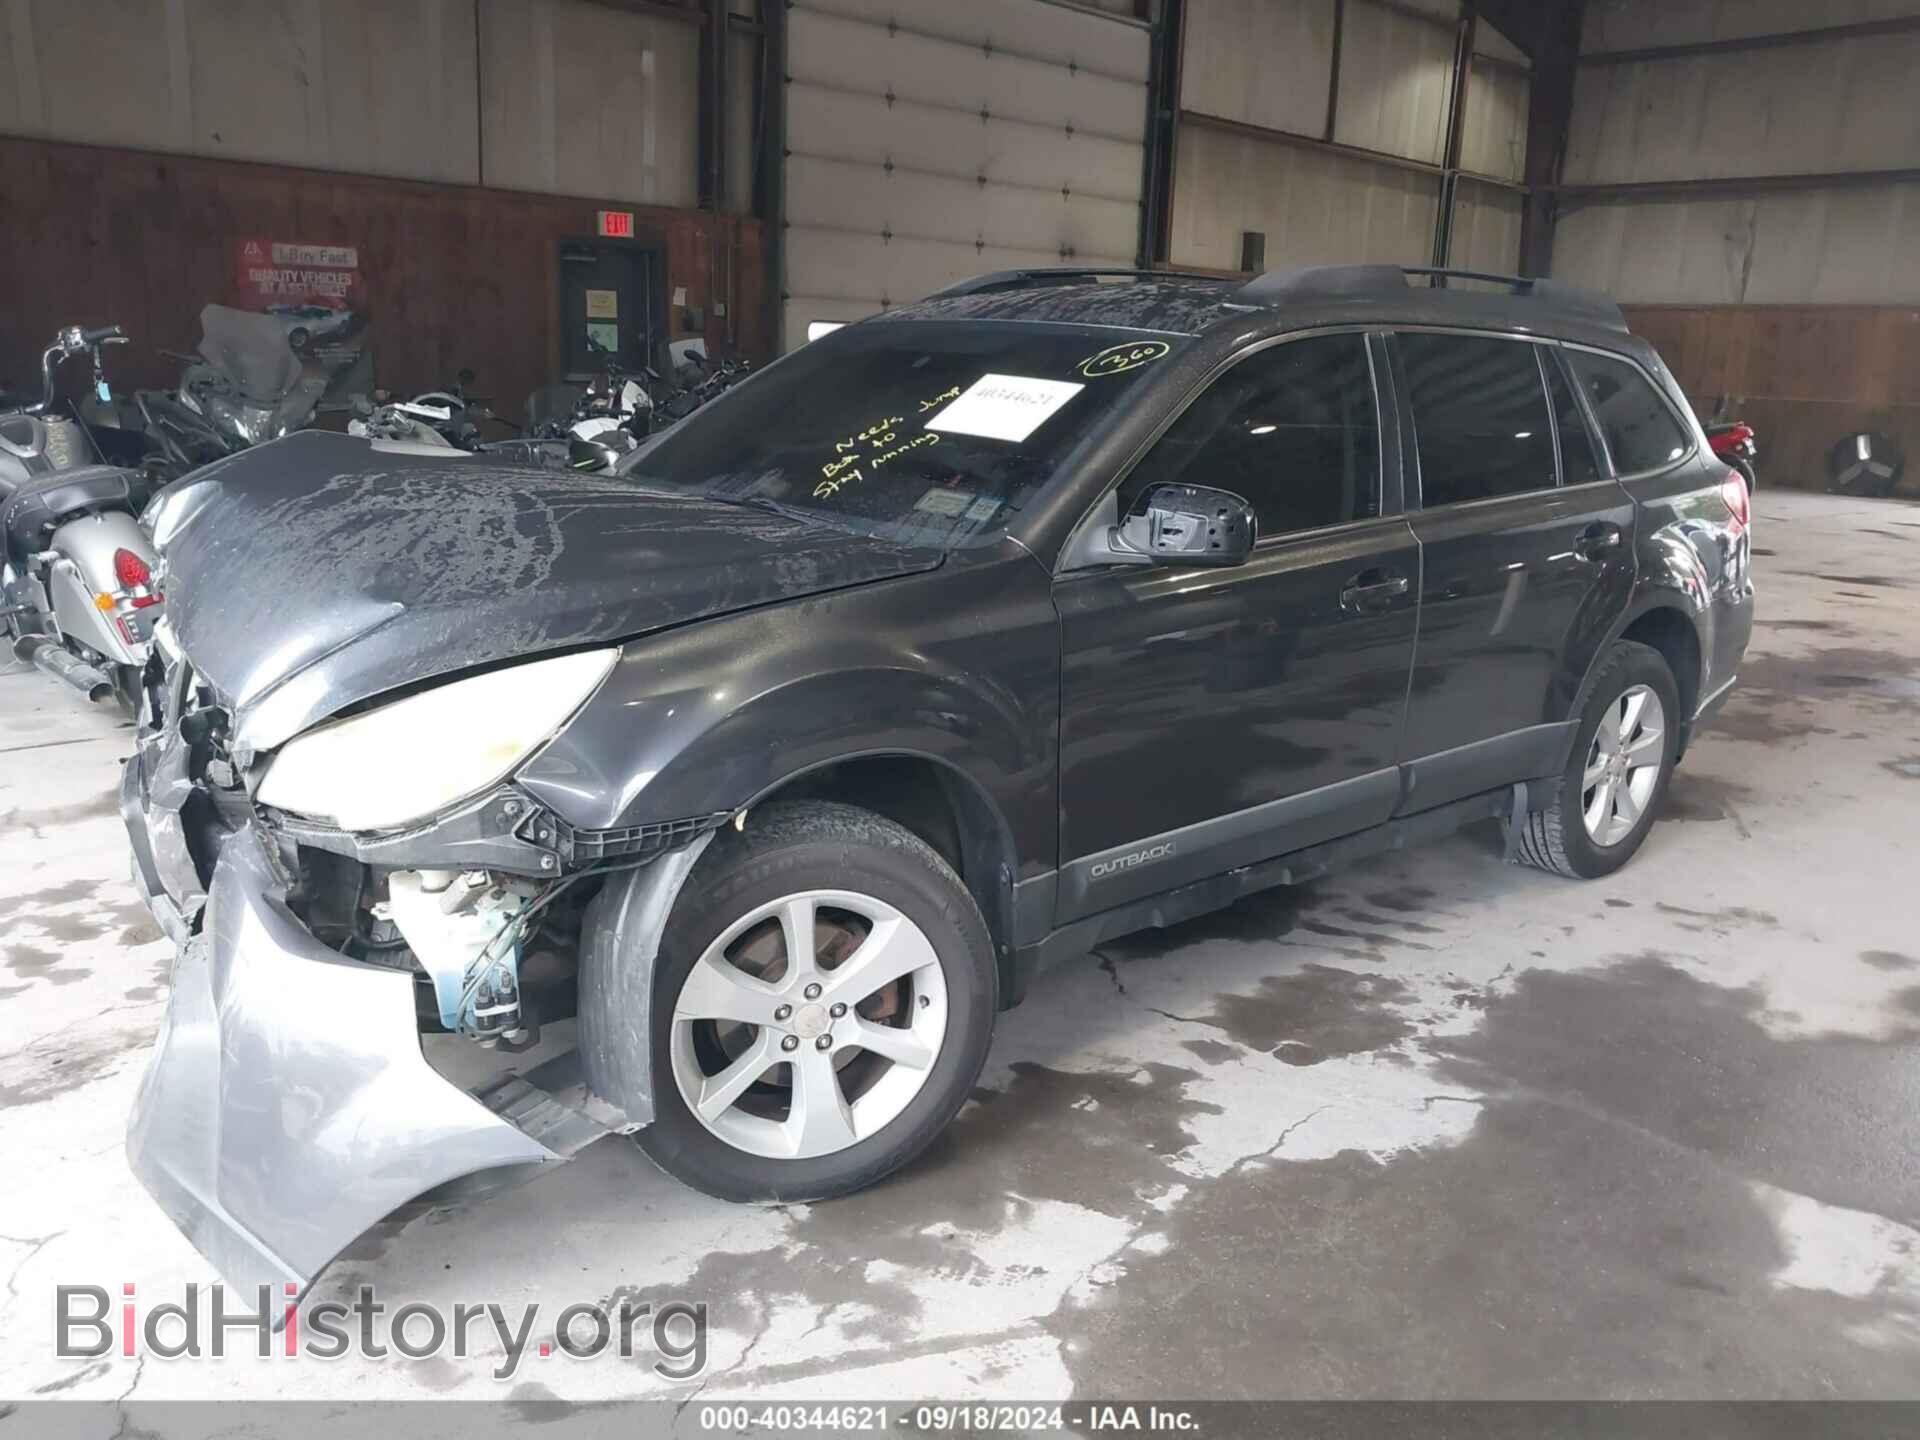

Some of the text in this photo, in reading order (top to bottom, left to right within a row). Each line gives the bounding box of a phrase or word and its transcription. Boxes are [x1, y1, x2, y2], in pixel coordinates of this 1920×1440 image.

[605, 213, 629, 233] EXIT
[249, 268, 352, 286] QUALITY VEHICLES
[871, 433, 940, 469] running
[1091, 842, 1173, 877] OUTBACK
